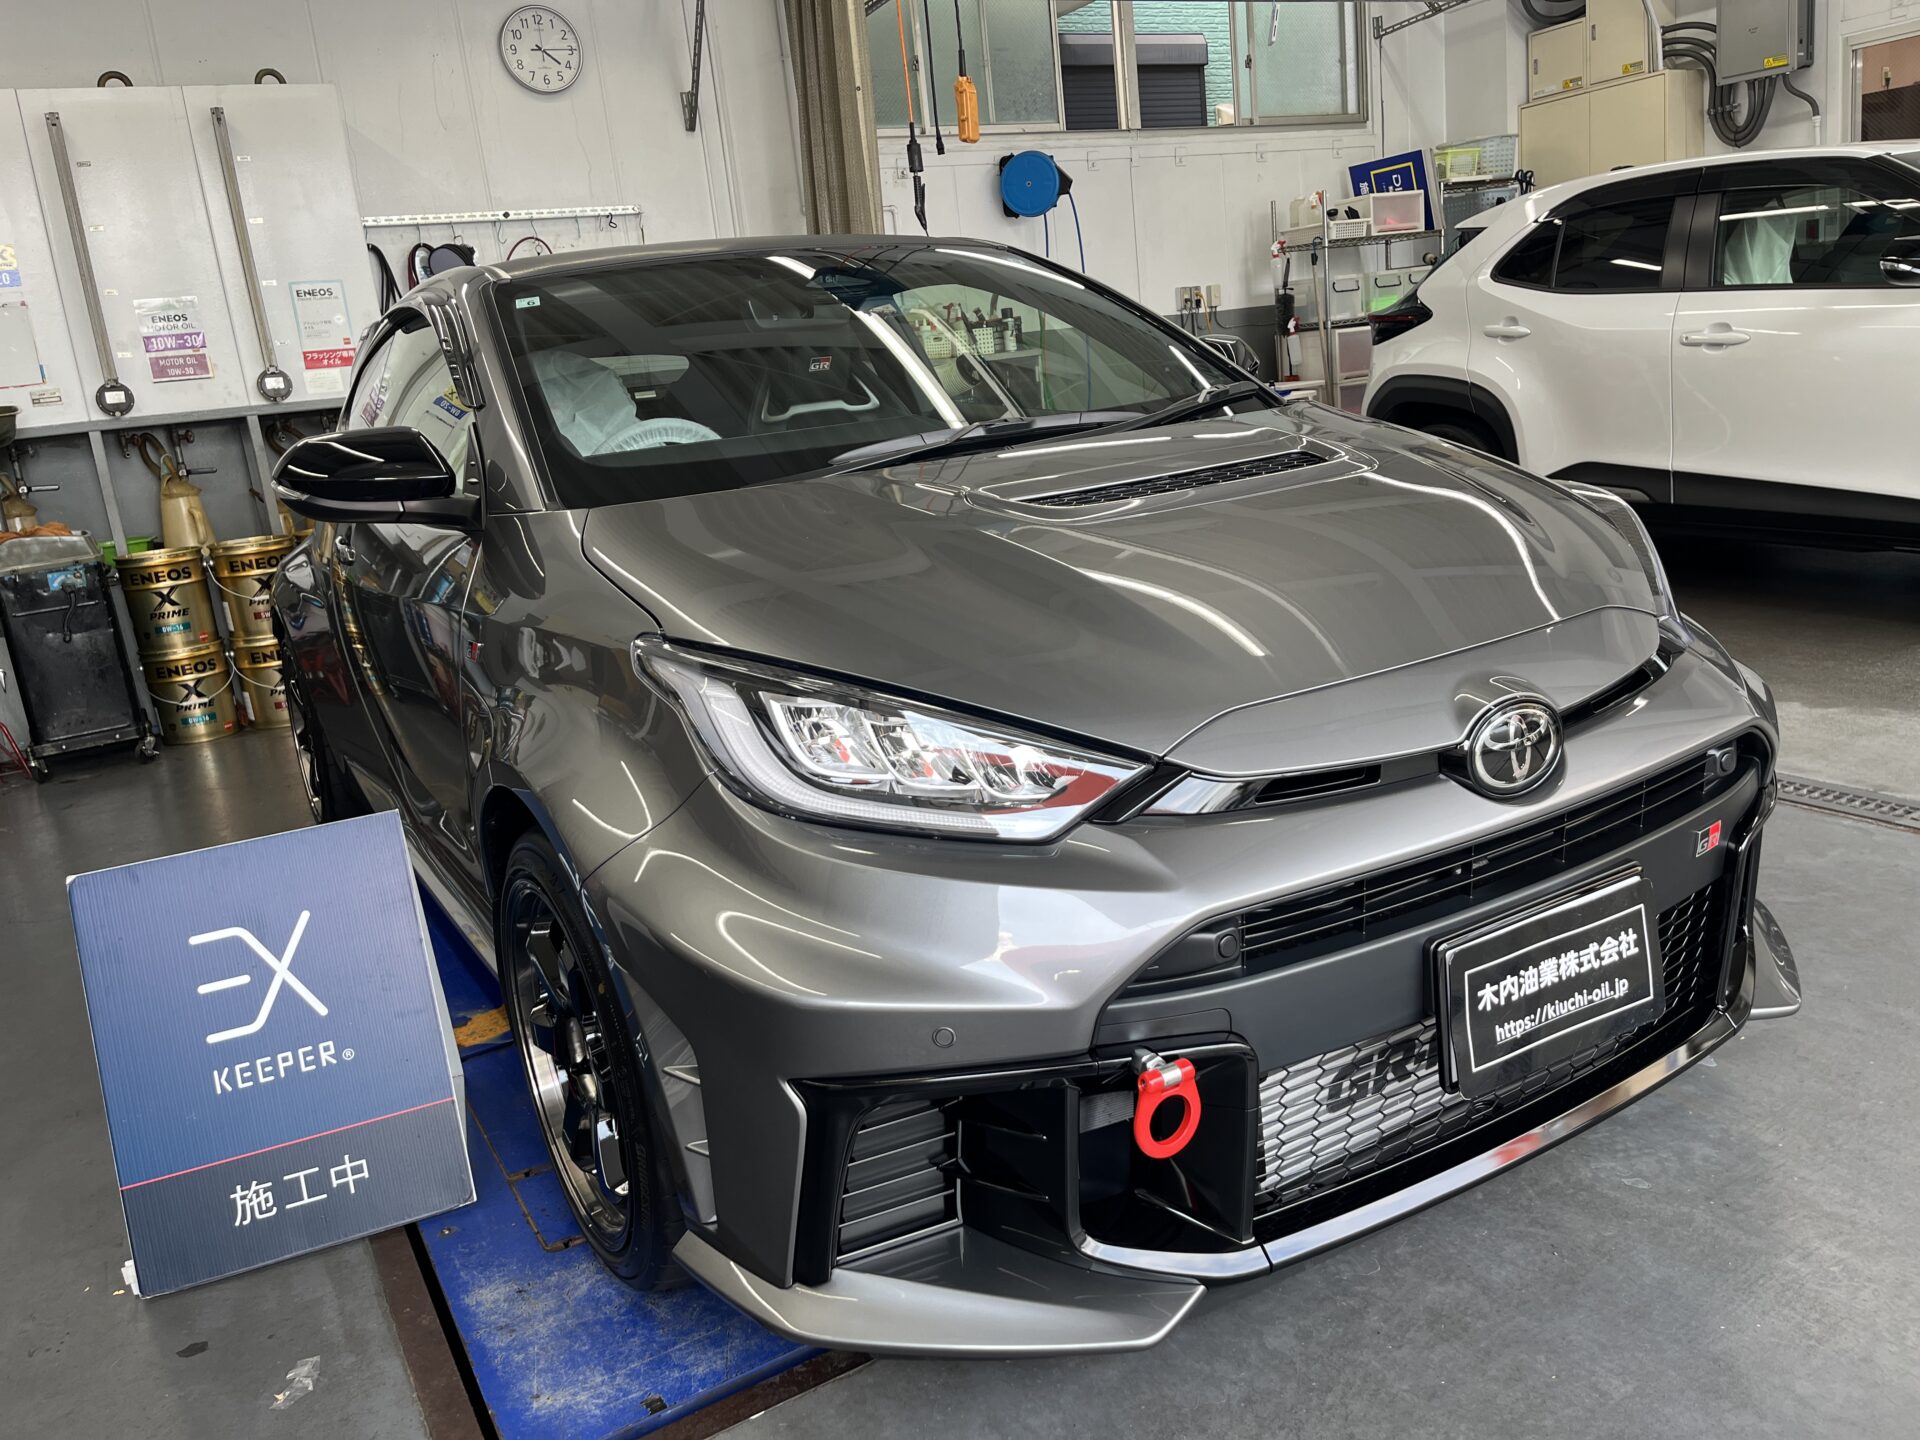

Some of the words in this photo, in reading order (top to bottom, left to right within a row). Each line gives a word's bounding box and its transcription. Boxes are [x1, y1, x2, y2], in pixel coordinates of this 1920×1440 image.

[520, 18, 529, 29] 11
[532, 14, 543, 25] 12
[511, 29, 522, 40] 10
[561, 30, 568, 40] 2
[510, 44, 517, 55] 9
[567, 45, 574, 56] 3
[516, 59, 524, 70] 8
[565, 60, 572, 70] 4
[529, 71, 536, 81] 7
[543, 75, 551, 85] 6
[557, 71, 564, 81] 5
[296, 287, 334, 298] ENEOS
[151, 314, 188, 324] ENEOS
[146, 323, 180, 332] OTOR
[181, 322, 197, 330] OIL
[150, 335, 199, 351] 10W-30
[159, 358, 185, 366] MOTOR
[186, 357, 198, 365] OIL
[322, 358, 342, 366] オイル
[167, 367, 195, 376] 10W-30
[130, 566, 192, 585] ENEOS
[151, 584, 181, 612] X
[150, 608, 190, 621] PRIME
[156, 658, 217, 678] ENEOS
[177, 679, 207, 703] X
[176, 699, 215, 712] PRIME
[1477, 927, 1639, 1012] 木内油業株式会社
[1494, 977, 1629, 1044] https://kiuchi-oil.jp
[229, 1154, 370, 1227] 施工中
